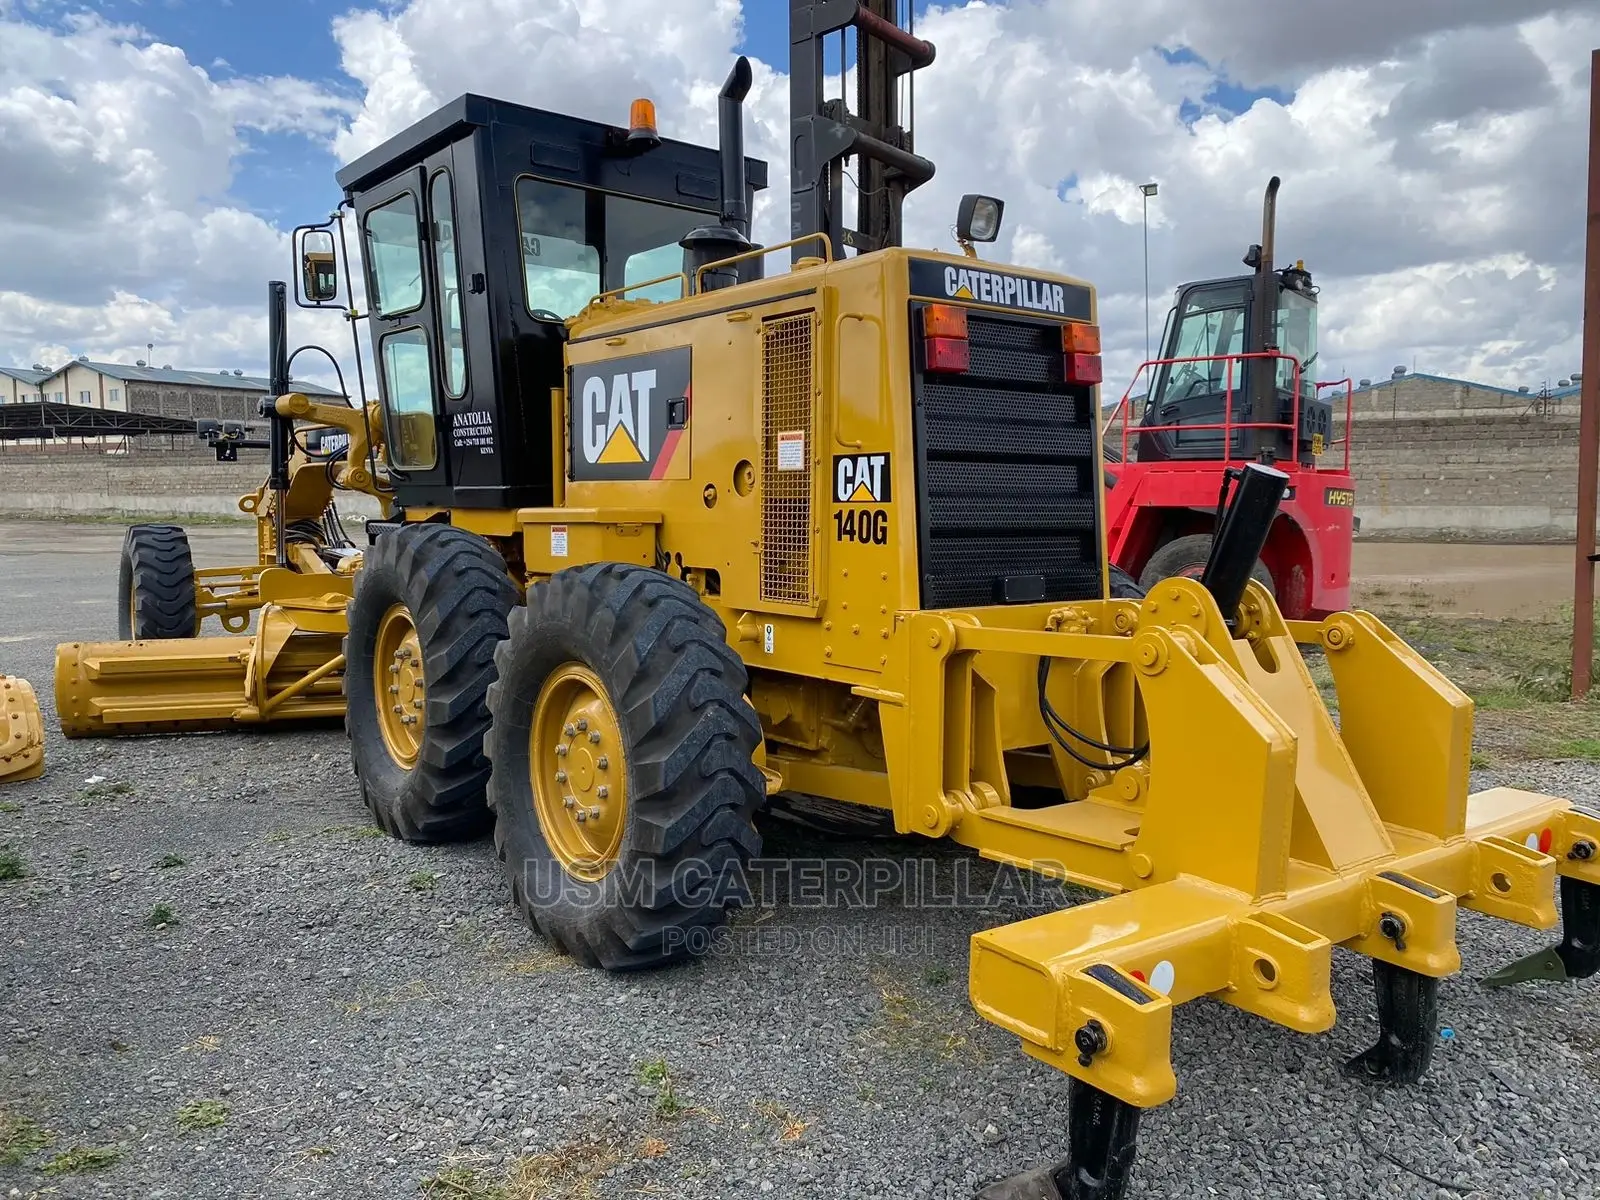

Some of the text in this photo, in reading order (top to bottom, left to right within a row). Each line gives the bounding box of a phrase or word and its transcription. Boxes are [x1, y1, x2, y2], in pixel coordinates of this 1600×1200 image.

[944, 266, 1065, 314] CATERPILLAR
[453, 411, 492, 427] ANATOLIA
[453, 426, 493, 437] CONSTRUCTION
[582, 369, 657, 464] CAT
[837, 455, 885, 502] CAT
[1328, 490, 1354, 505] HYSTE
[833, 509, 888, 545] 140G
